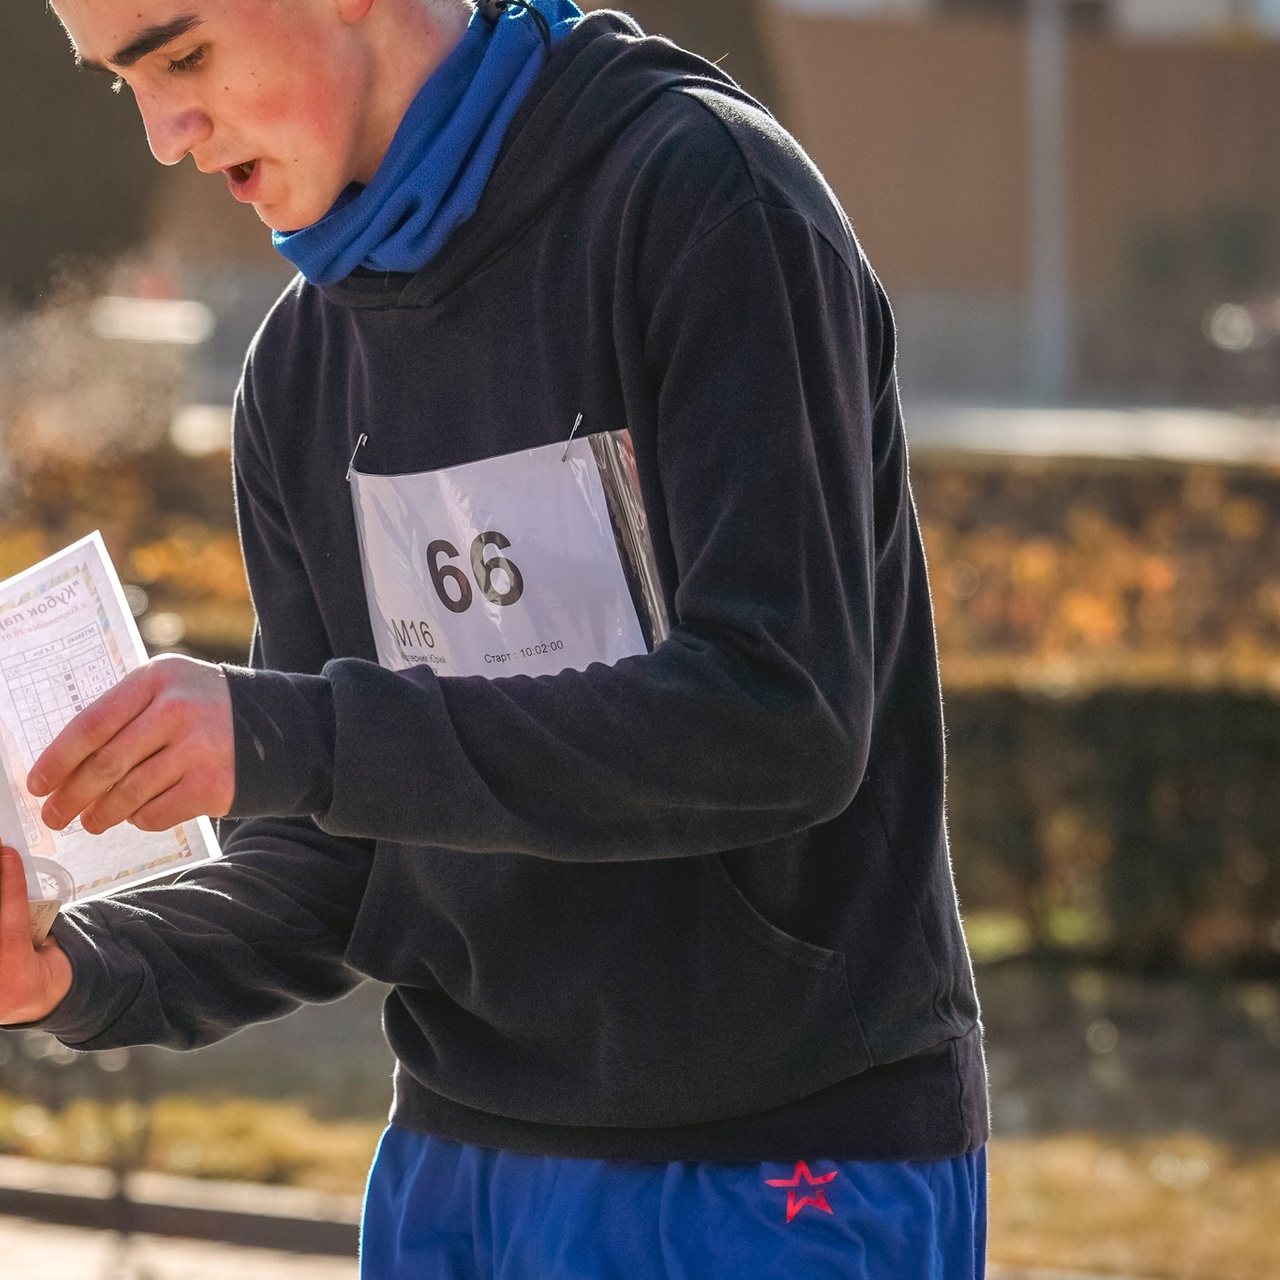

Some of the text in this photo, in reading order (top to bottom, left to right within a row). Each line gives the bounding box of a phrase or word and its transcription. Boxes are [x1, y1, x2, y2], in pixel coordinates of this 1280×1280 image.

[426, 531, 524, 614] 66
[484, 652, 511, 664] Старт
[520, 640, 564, 658] 10:02:00
